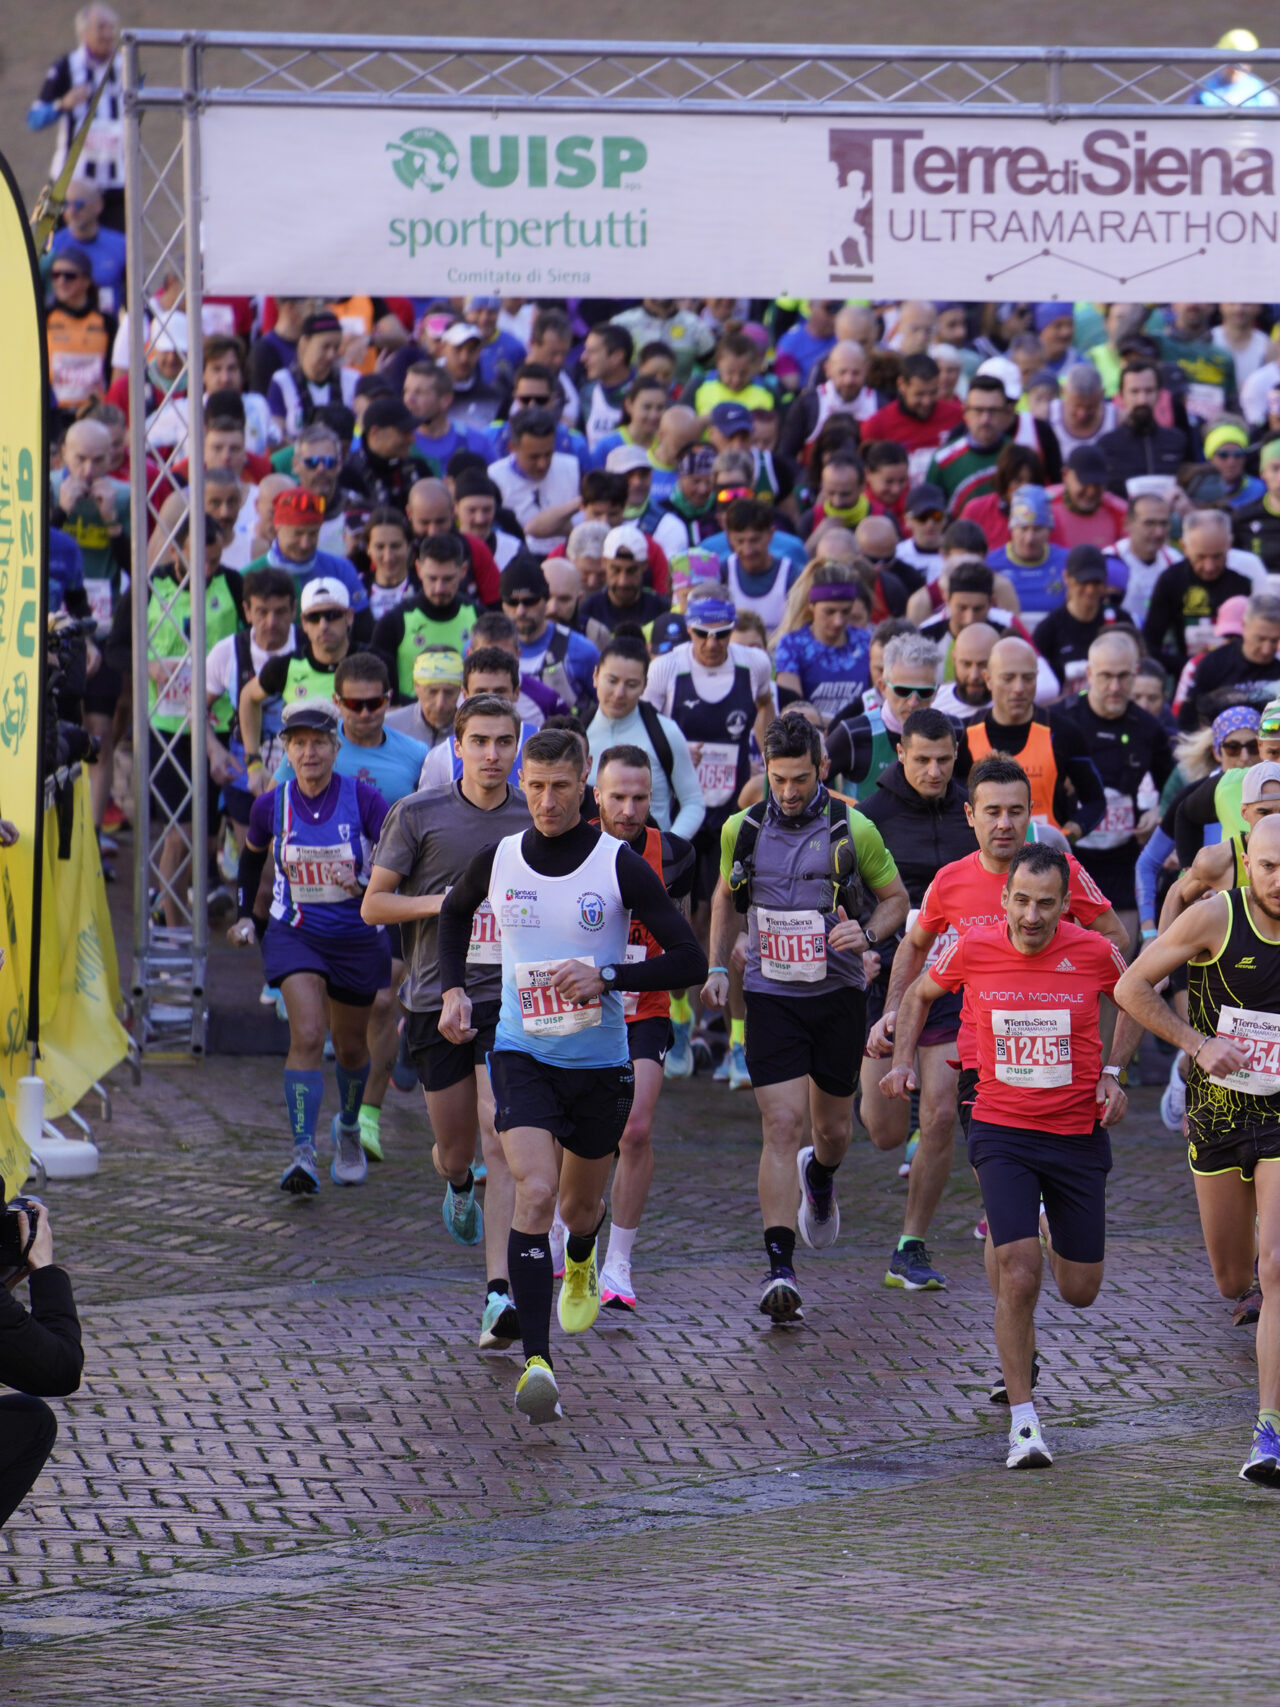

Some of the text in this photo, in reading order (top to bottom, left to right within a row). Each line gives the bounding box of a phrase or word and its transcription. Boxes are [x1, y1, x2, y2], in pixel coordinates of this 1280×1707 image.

[469, 134, 648, 189] UISP
[388, 207, 648, 259] sportpertutti
[888, 209, 1279, 244] ULTRAMARATHON
[446, 267, 592, 284] Comitato di Siena
[698, 763, 726, 789] 065
[298, 861, 343, 885] 116
[959, 914, 999, 927] AURORA
[768, 934, 814, 961] 1015
[978, 990, 1084, 1003] AURORA MONTALE
[543, 1015, 564, 1024] UISP
[1006, 1036, 1059, 1065] 1245
[1013, 1067, 1034, 1075] UISP
[588, 1261, 598, 1297] HOKA
